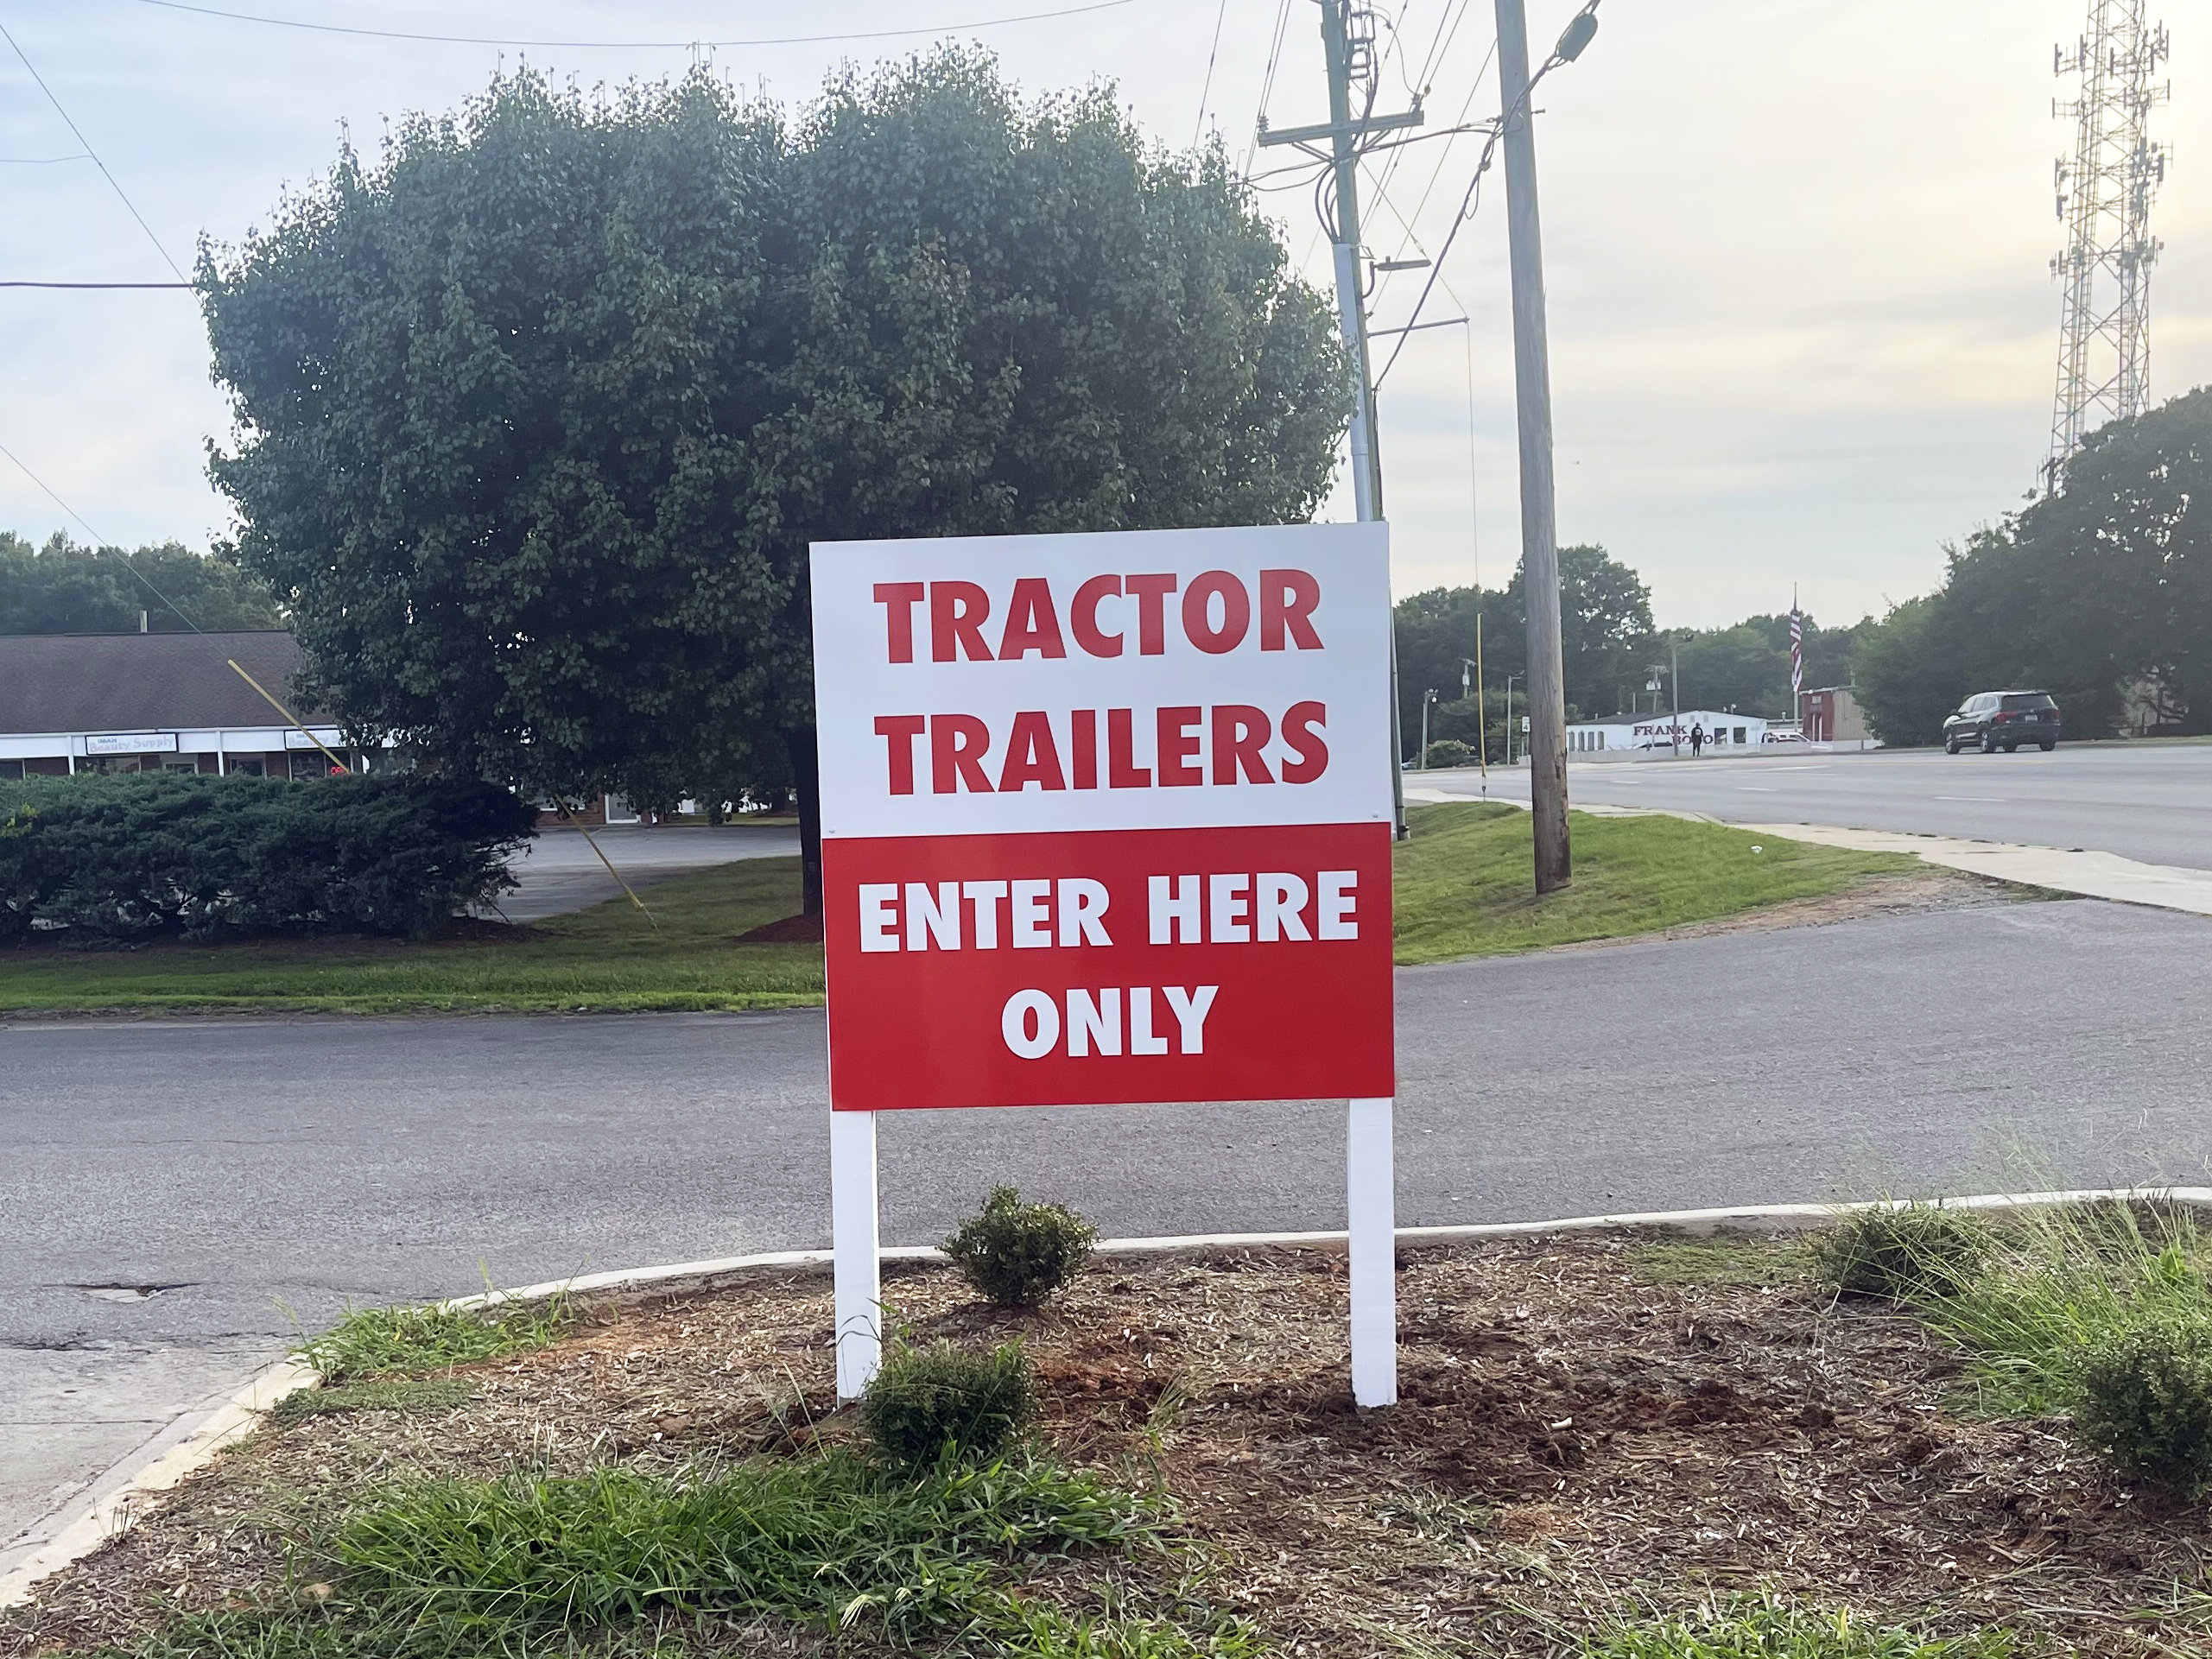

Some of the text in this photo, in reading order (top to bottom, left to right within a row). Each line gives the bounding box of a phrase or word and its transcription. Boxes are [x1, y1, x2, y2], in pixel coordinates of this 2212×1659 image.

[873, 570, 1323, 663] TRACTOR
[133, 735, 174, 749] Supply
[874, 701, 1329, 795] TRAILERS
[1633, 725, 1687, 736] FRANK
[1672, 735, 1714, 745] BOO
[859, 870, 1359, 953] ENTER HERE
[1001, 985, 1220, 1060] ONLY
